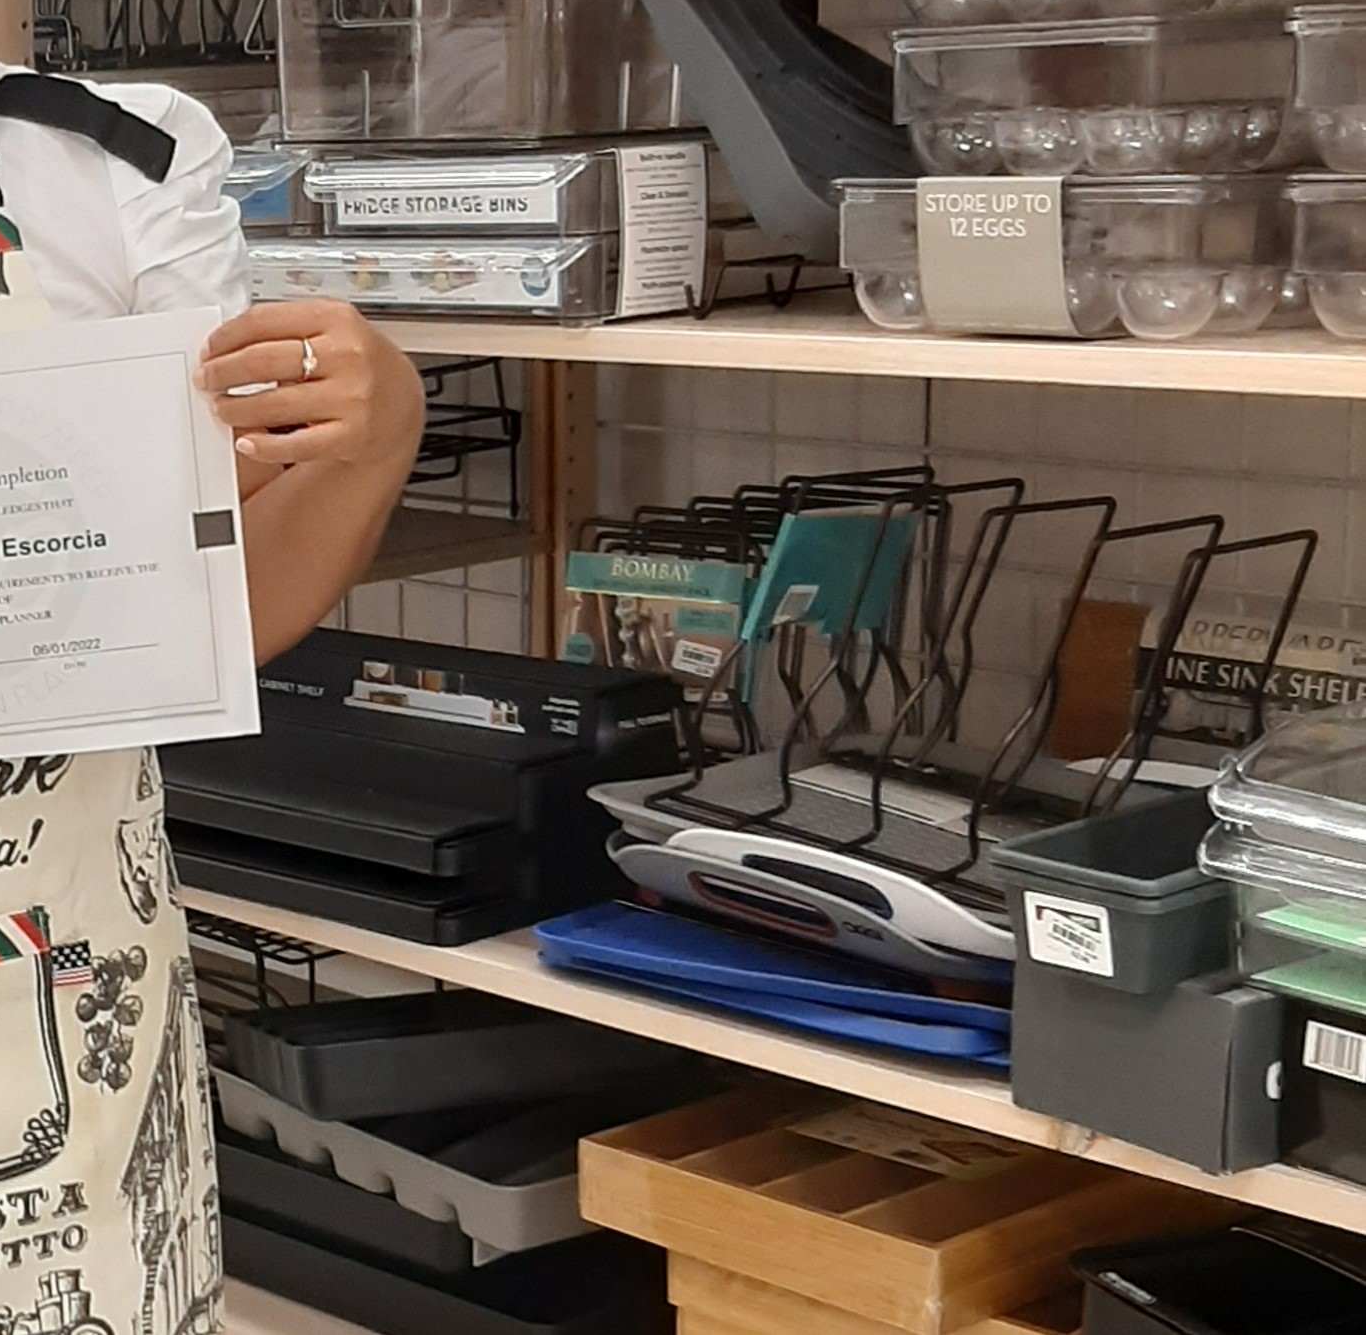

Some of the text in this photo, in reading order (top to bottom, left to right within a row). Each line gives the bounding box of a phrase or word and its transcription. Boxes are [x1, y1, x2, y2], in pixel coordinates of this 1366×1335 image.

[344, 195, 529, 216] FRIDGE STORAGE BINS
[925, 193, 1052, 214] STORE UP TO
[950, 217, 1027, 238] 12 EGGS
[44, 498, 75, 510] THAT
[1, 529, 108, 558] Escorcia
[67, 571, 84, 581] TO
[85, 565, 134, 580] RECEIVE
[137, 562, 160, 574] THE
[611, 557, 696, 582] BOMBAY
[0, 609, 54, 625] PLANNER
[32, 637, 102, 657] 06/01/2022
[1215, 663, 1281, 696] SINK
[1286, 672, 1366, 706] SHELF
